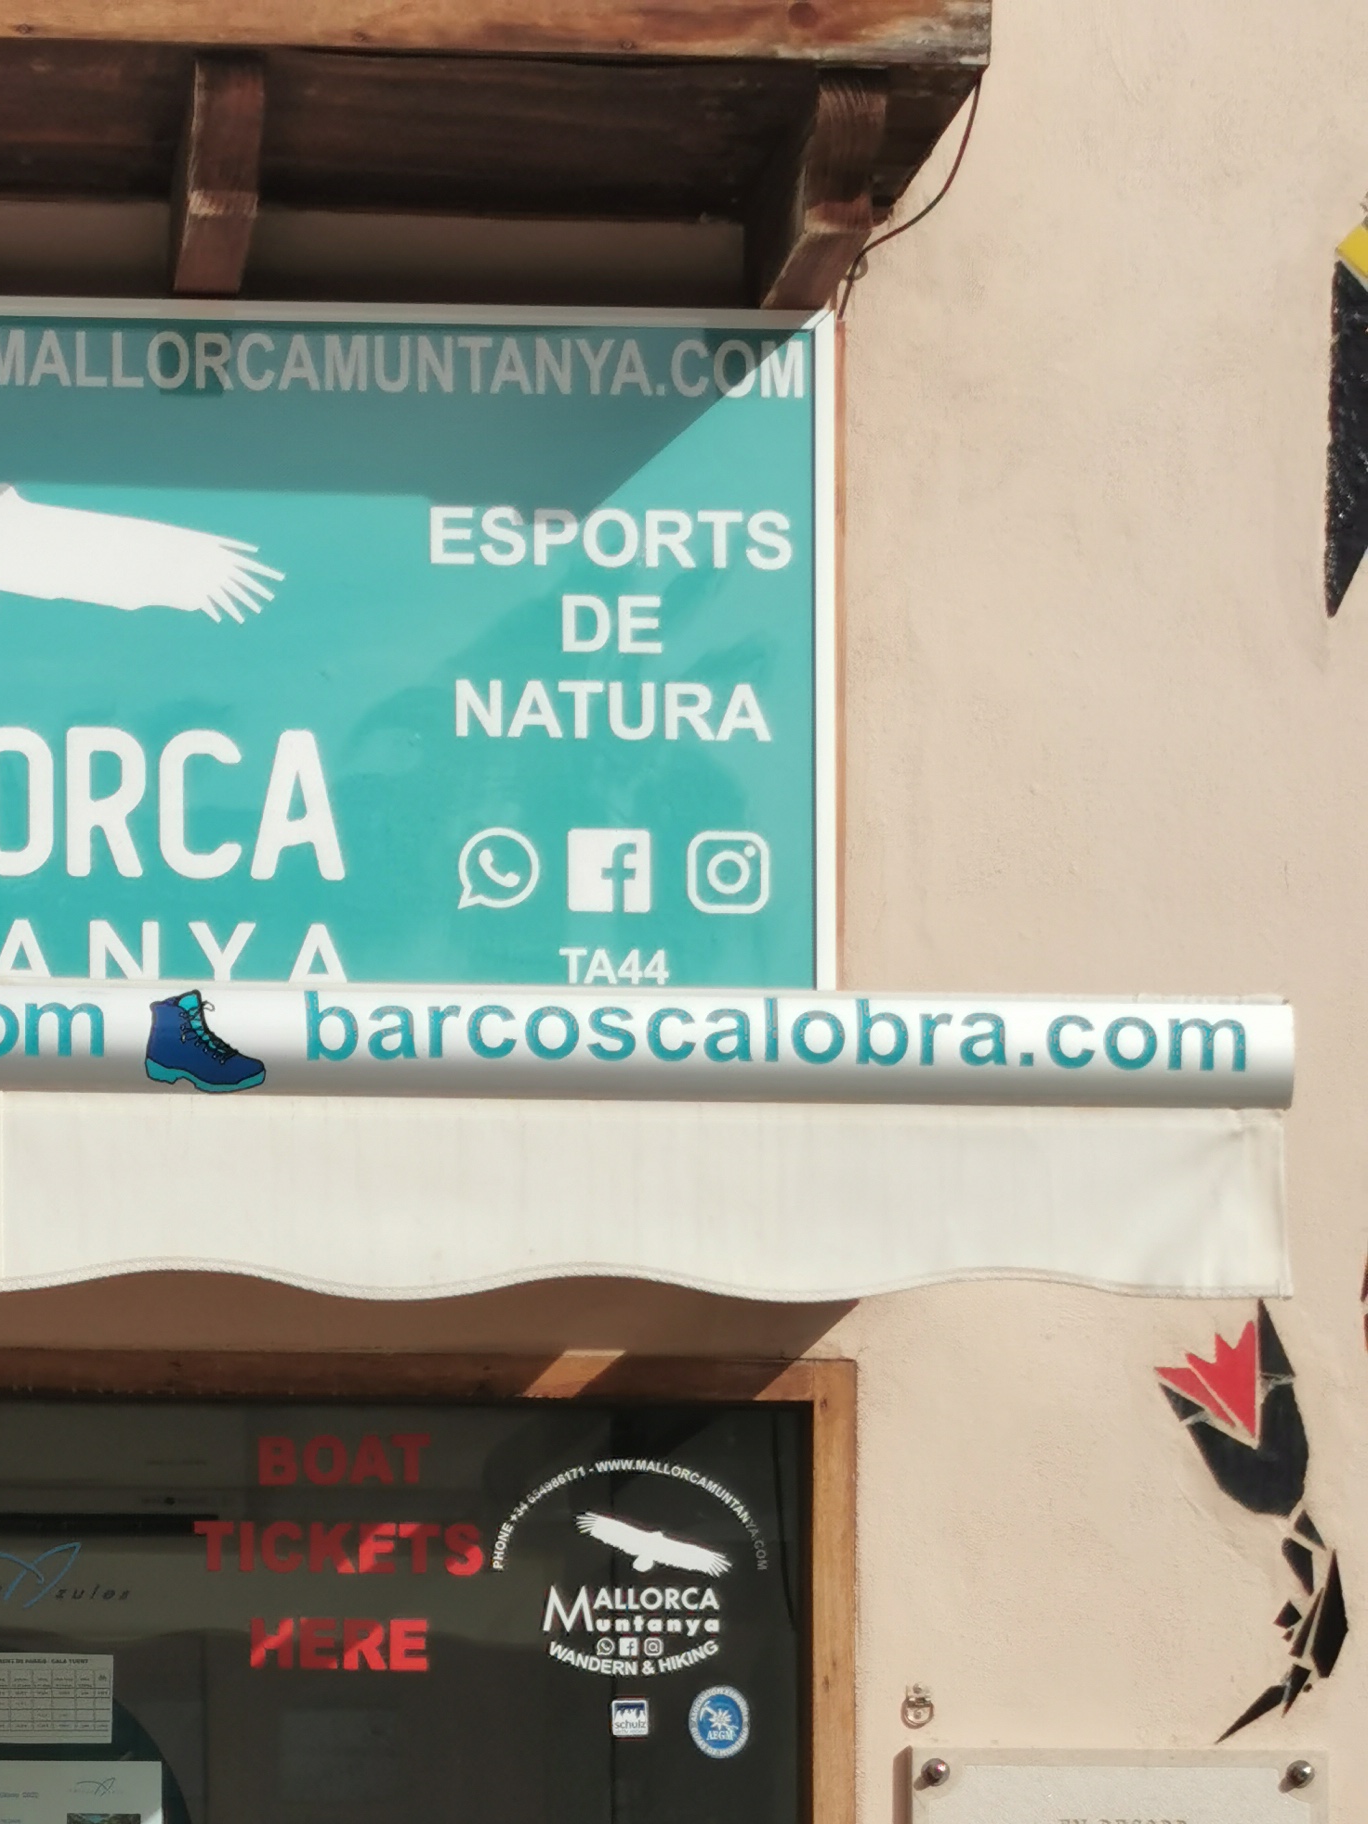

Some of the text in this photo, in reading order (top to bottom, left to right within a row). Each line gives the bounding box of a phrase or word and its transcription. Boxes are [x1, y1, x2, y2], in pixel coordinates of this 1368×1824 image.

[430, 505, 793, 571] ESPORTS
[561, 594, 664, 655] DE
[455, 679, 772, 742] NATURA
[558, 947, 670, 985] TA44
[304, 989, 1249, 1074] barcoscalobra.com
[257, 1433, 430, 1487] BOAT
[492, 1522, 514, 1572] PHONE
[526, 1465, 586, 1505] 654986171
[595, 1458, 769, 1572] WWW.MALLORCAMUNTANYA.COM
[193, 1520, 483, 1577] TICKETS
[542, 1585, 720, 1634] MALLORCA
[249, 1616, 428, 1673] HERE
[549, 1638, 721, 1677] WANDERN & HIKING
[614, 1719, 647, 1729] schulz
